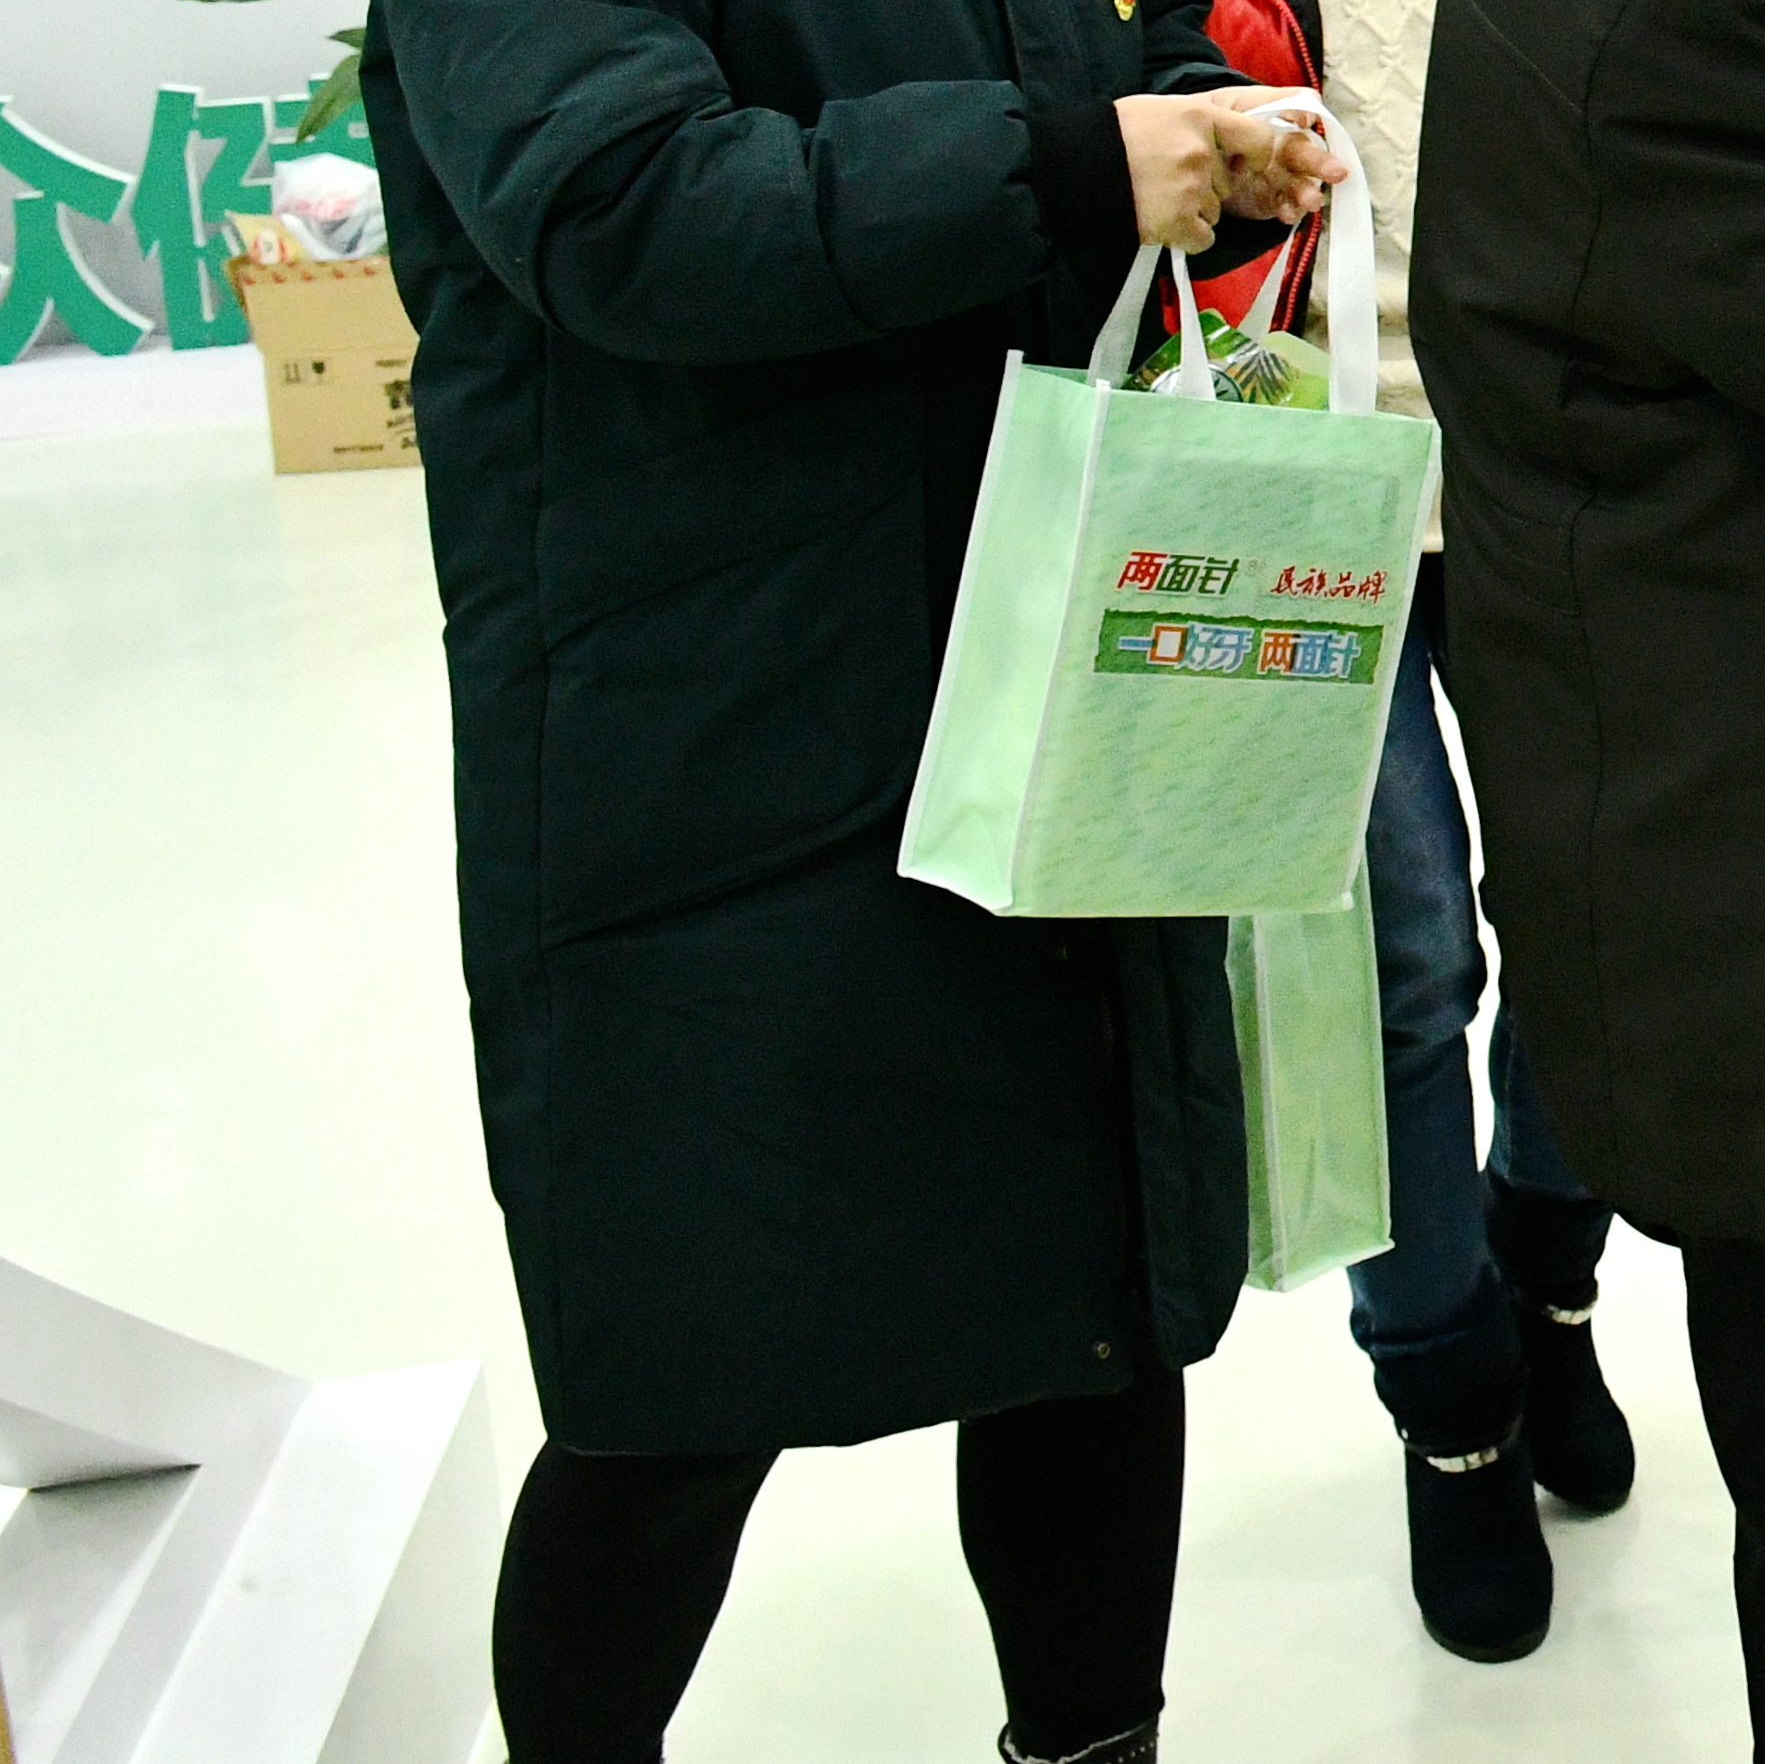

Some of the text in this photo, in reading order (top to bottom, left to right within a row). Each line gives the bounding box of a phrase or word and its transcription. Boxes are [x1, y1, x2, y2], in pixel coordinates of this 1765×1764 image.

[1116, 549, 1389, 605] 两面针 民族品牌
[1117, 621, 1361, 678] 一口好牙 两面针
